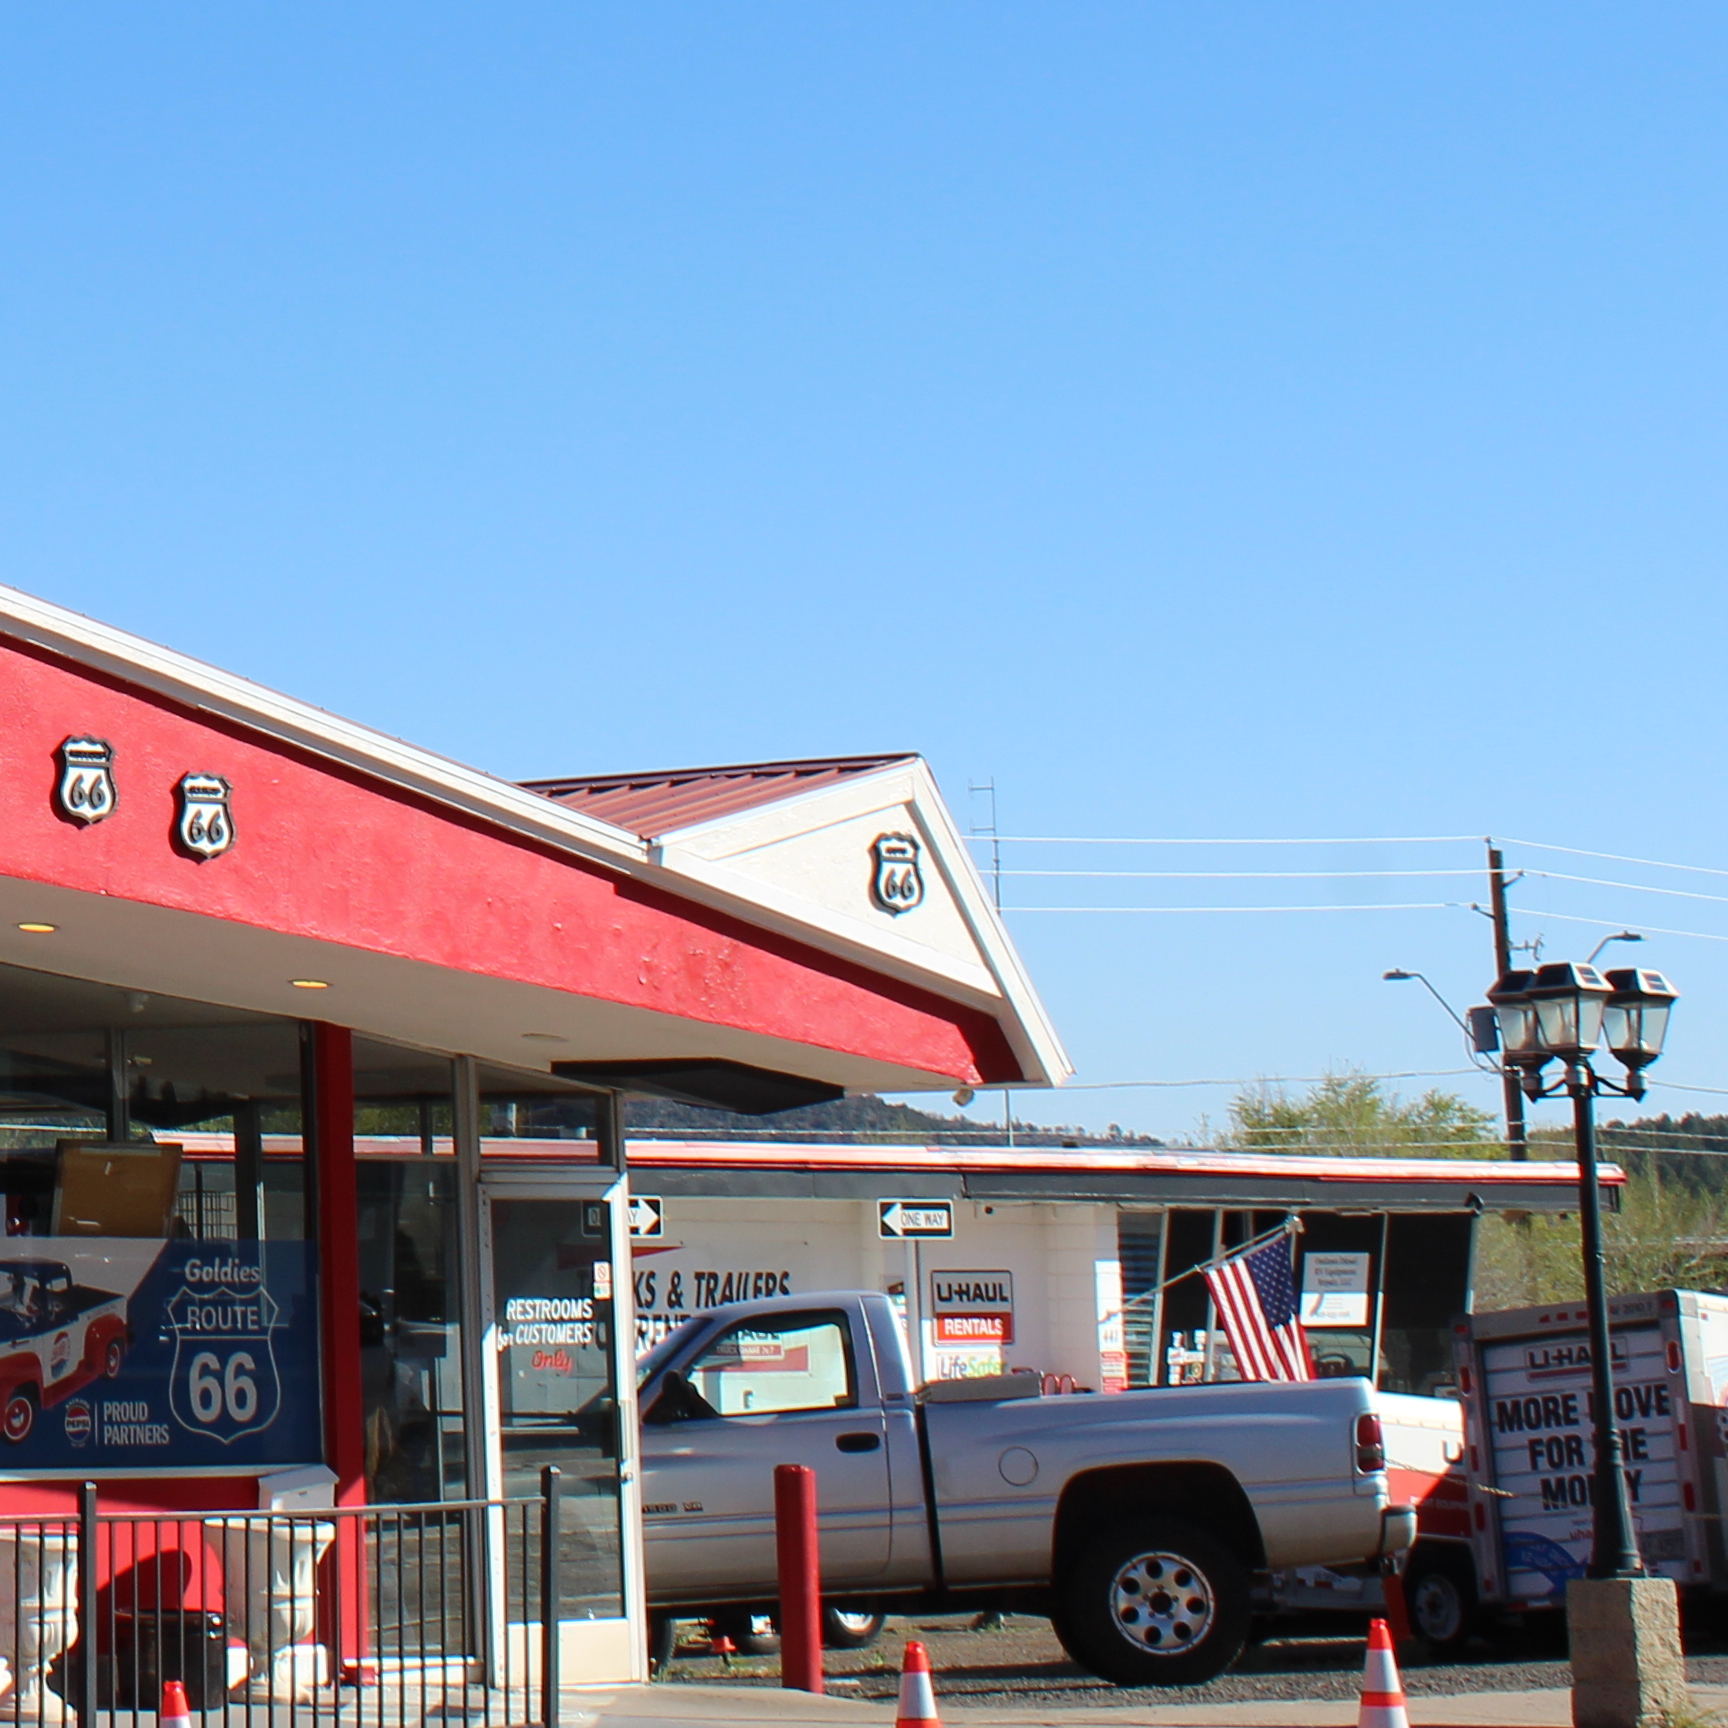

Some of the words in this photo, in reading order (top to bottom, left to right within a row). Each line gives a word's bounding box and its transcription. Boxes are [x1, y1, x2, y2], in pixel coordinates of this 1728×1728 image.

[68, 773, 107, 811] 66
[187, 808, 225, 845] 66
[884, 867, 915, 901] 66
[901, 1212, 922, 1227] ONE
[924, 1212, 945, 1226] WAY
[184, 1258, 261, 1283] Goldies
[666, 1270, 684, 1309] &
[936, 1281, 1010, 1303] U-HAUL
[187, 1306, 260, 1330] ROUTE
[506, 1297, 594, 1321] RESTROOMS
[515, 1322, 593, 1345] CUSTOMERS
[944, 1317, 1004, 1336] RENTALS
[532, 1349, 574, 1376] Only
[1528, 1341, 1627, 1370] U-HAL
[188, 1351, 258, 1423] 66
[103, 1401, 149, 1422] PROUD
[1496, 1392, 1580, 1434] MORE
[1586, 1383, 1672, 1424] OVE
[103, 1424, 170, 1445] PARTNERS
[1528, 1433, 1586, 1471] FOR
[1539, 1467, 1644, 1511] MOY
